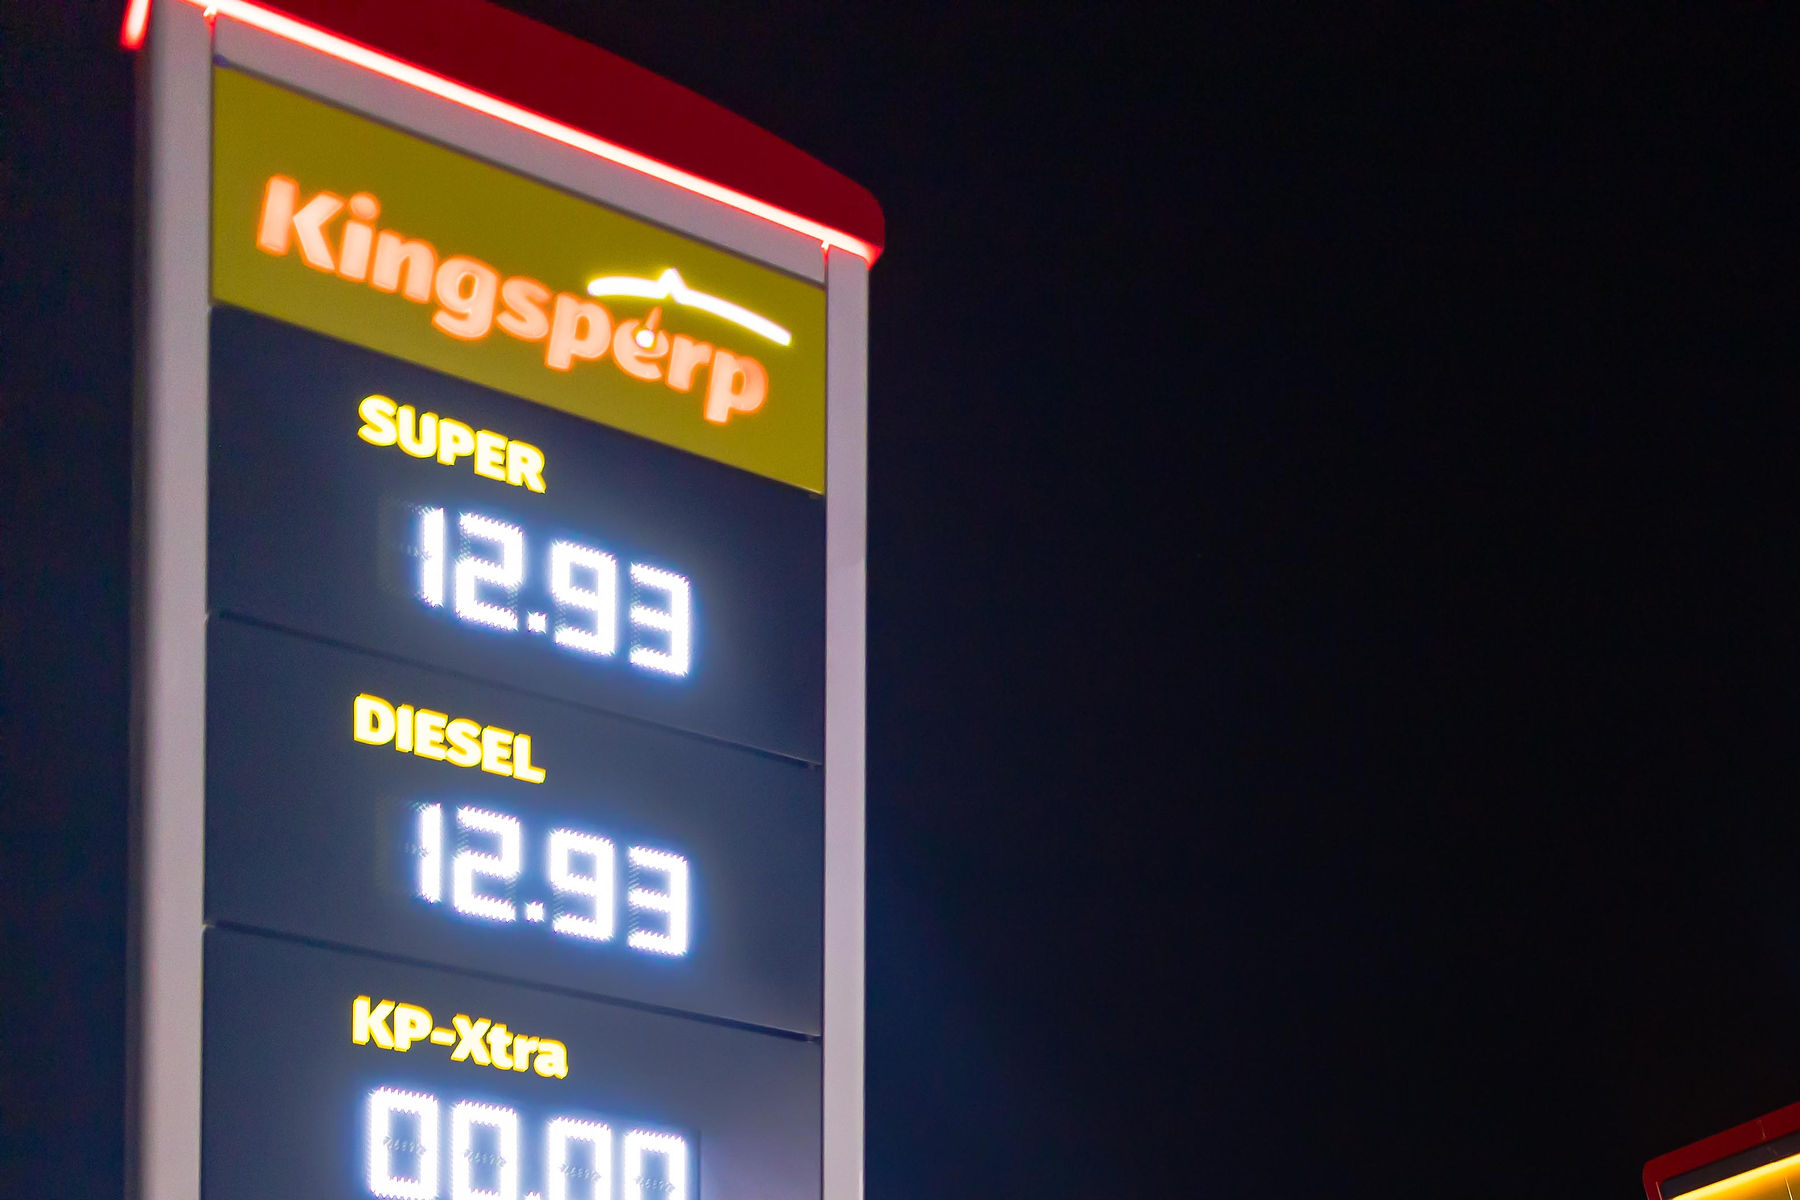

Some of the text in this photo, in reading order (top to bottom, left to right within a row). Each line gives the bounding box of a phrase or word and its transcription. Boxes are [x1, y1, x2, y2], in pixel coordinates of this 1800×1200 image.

[256, 174, 769, 424] Kingsperp
[357, 395, 546, 493] SUPER
[419, 506, 691, 677] 12.93
[353, 693, 546, 783] DIESEL
[419, 802, 689, 957] 12.93
[351, 995, 569, 1079] KP-Xtra
